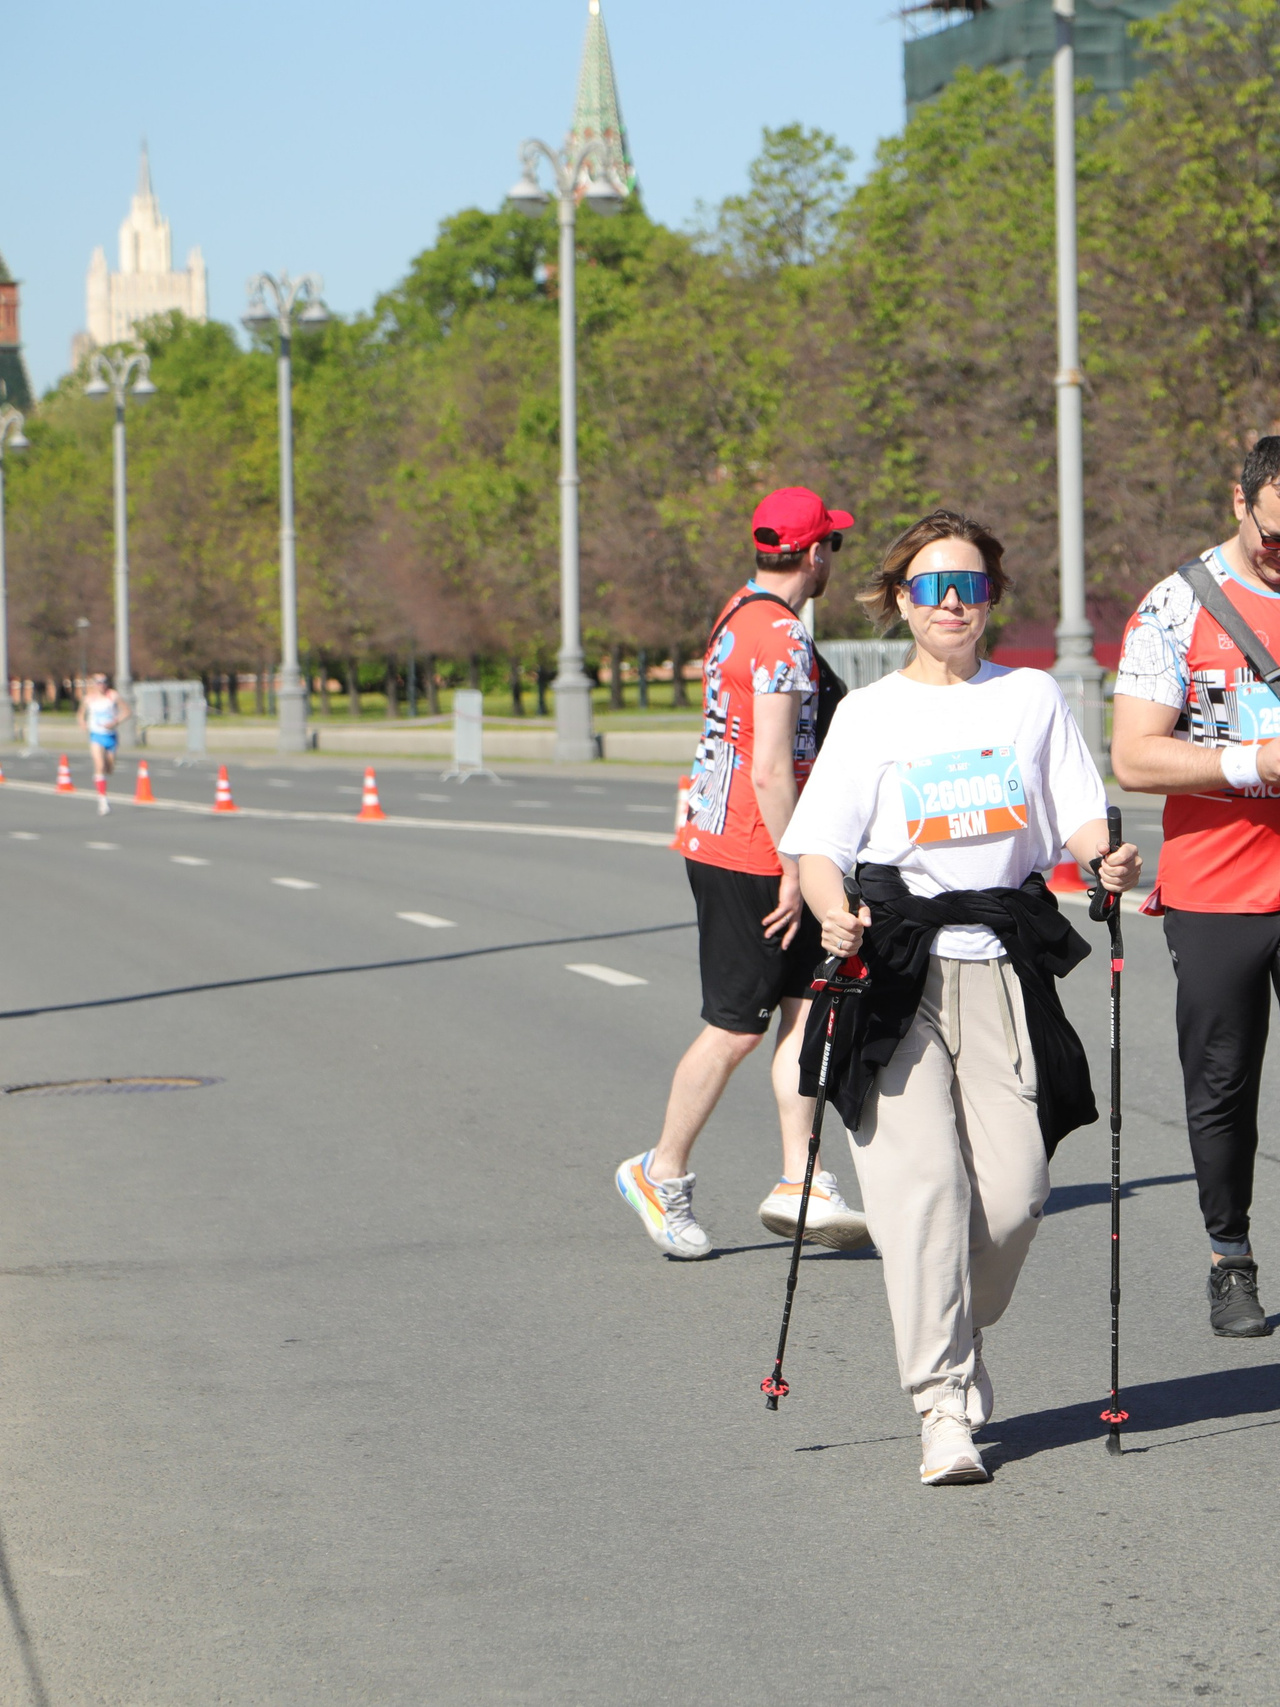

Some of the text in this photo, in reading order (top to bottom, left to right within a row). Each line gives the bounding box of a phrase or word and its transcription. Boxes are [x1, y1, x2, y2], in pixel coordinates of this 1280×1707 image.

[922, 773, 1004, 814] 26006
[1008, 779, 1019, 791] D
[947, 810, 988, 840] 5KM
